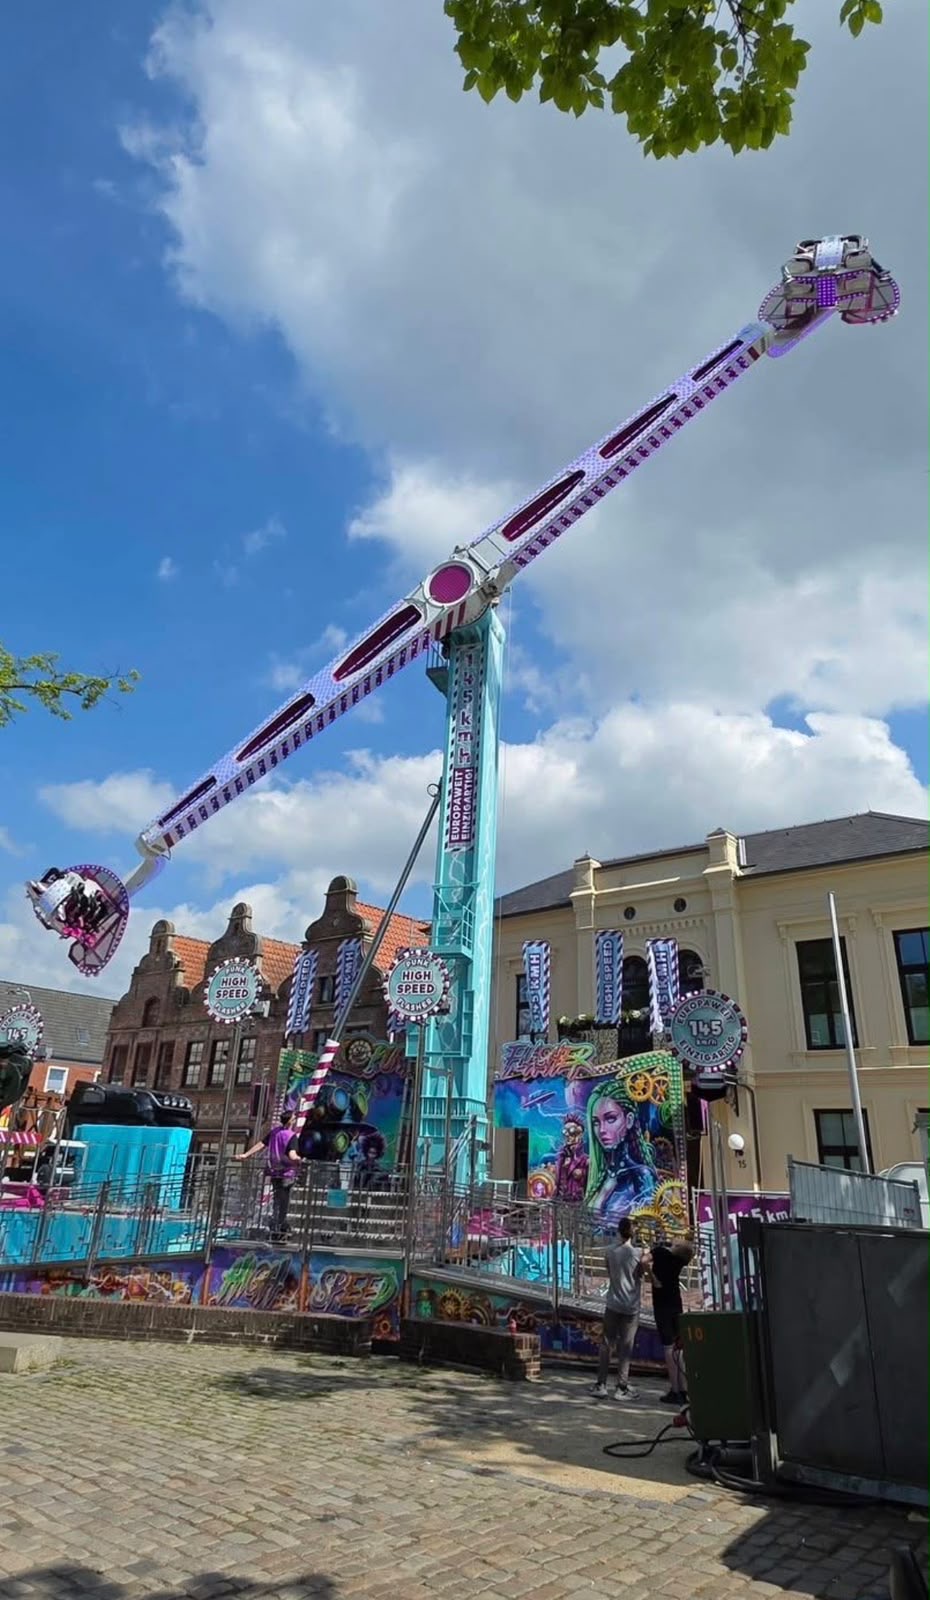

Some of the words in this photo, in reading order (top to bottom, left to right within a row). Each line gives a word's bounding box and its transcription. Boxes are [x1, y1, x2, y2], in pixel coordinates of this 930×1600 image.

[450, 770, 464, 841] EUROPAWEIT
[461, 768, 474, 840] EINZIGARTIG!
[405, 959, 429, 967] PUNK
[603, 939, 613, 981] SPEED
[225, 965, 246, 975] PUNK
[299, 958, 311, 995] SPEED
[402, 971, 432, 981] HIGH
[528, 953, 541, 991] KMH
[221, 976, 248, 987] HIGH
[396, 983, 435, 994] SPEED
[215, 988, 249, 999] SPEED
[603, 984, 613, 1017] HIGH
[397, 997, 432, 1012] FLASHER
[677, 999, 735, 1025] EUROPAWEIT
[7, 1027, 29, 1041] 145
[688, 1020, 724, 1037] 145
[679, 1035, 736, 1061] EINZIGARTIG
[738, 1159, 747, 1169] 15
[309, 1264, 398, 1317] SPEED
